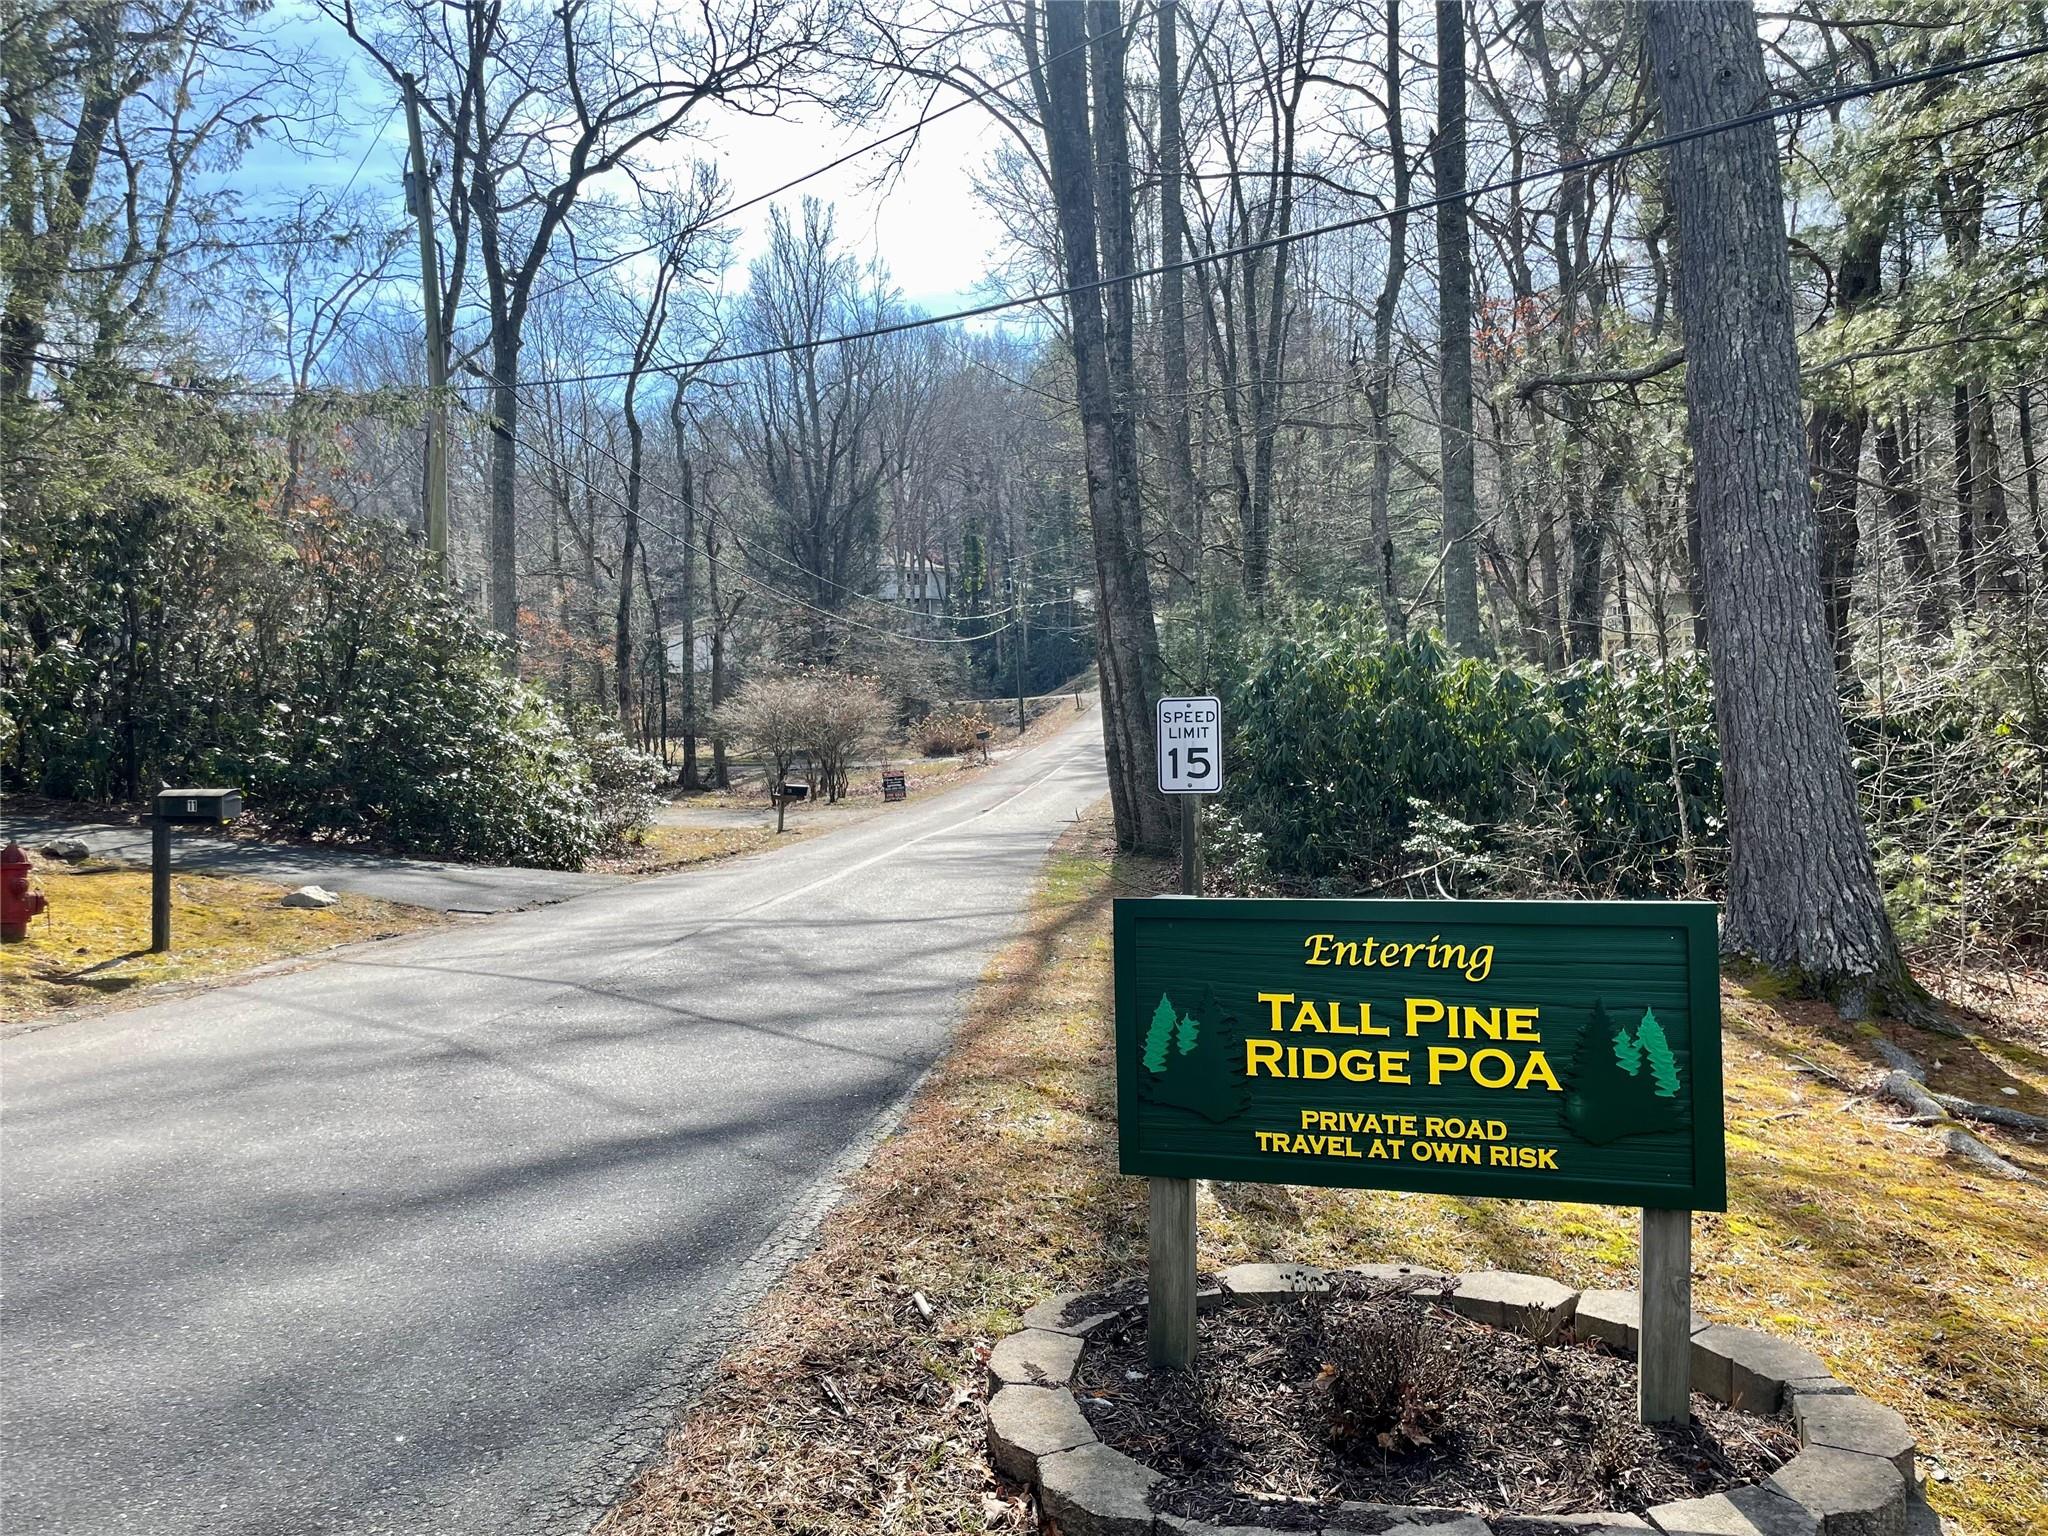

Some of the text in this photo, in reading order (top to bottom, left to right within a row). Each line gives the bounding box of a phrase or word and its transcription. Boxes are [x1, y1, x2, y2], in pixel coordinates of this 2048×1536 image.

[1162, 711, 1216, 724] SPEED
[1168, 727, 1209, 739] LIMIT
[1168, 747, 1211, 779] 15
[187, 800, 198, 812] 11
[1304, 934, 1494, 982] Entering
[1257, 992, 1541, 1043] TALL PINE
[1245, 1038, 1563, 1091] RIDGE POA
[1301, 1110, 1508, 1140] PRIVATE ROAD
[1255, 1131, 1559, 1170] TRAVEL AT OWN RISK
